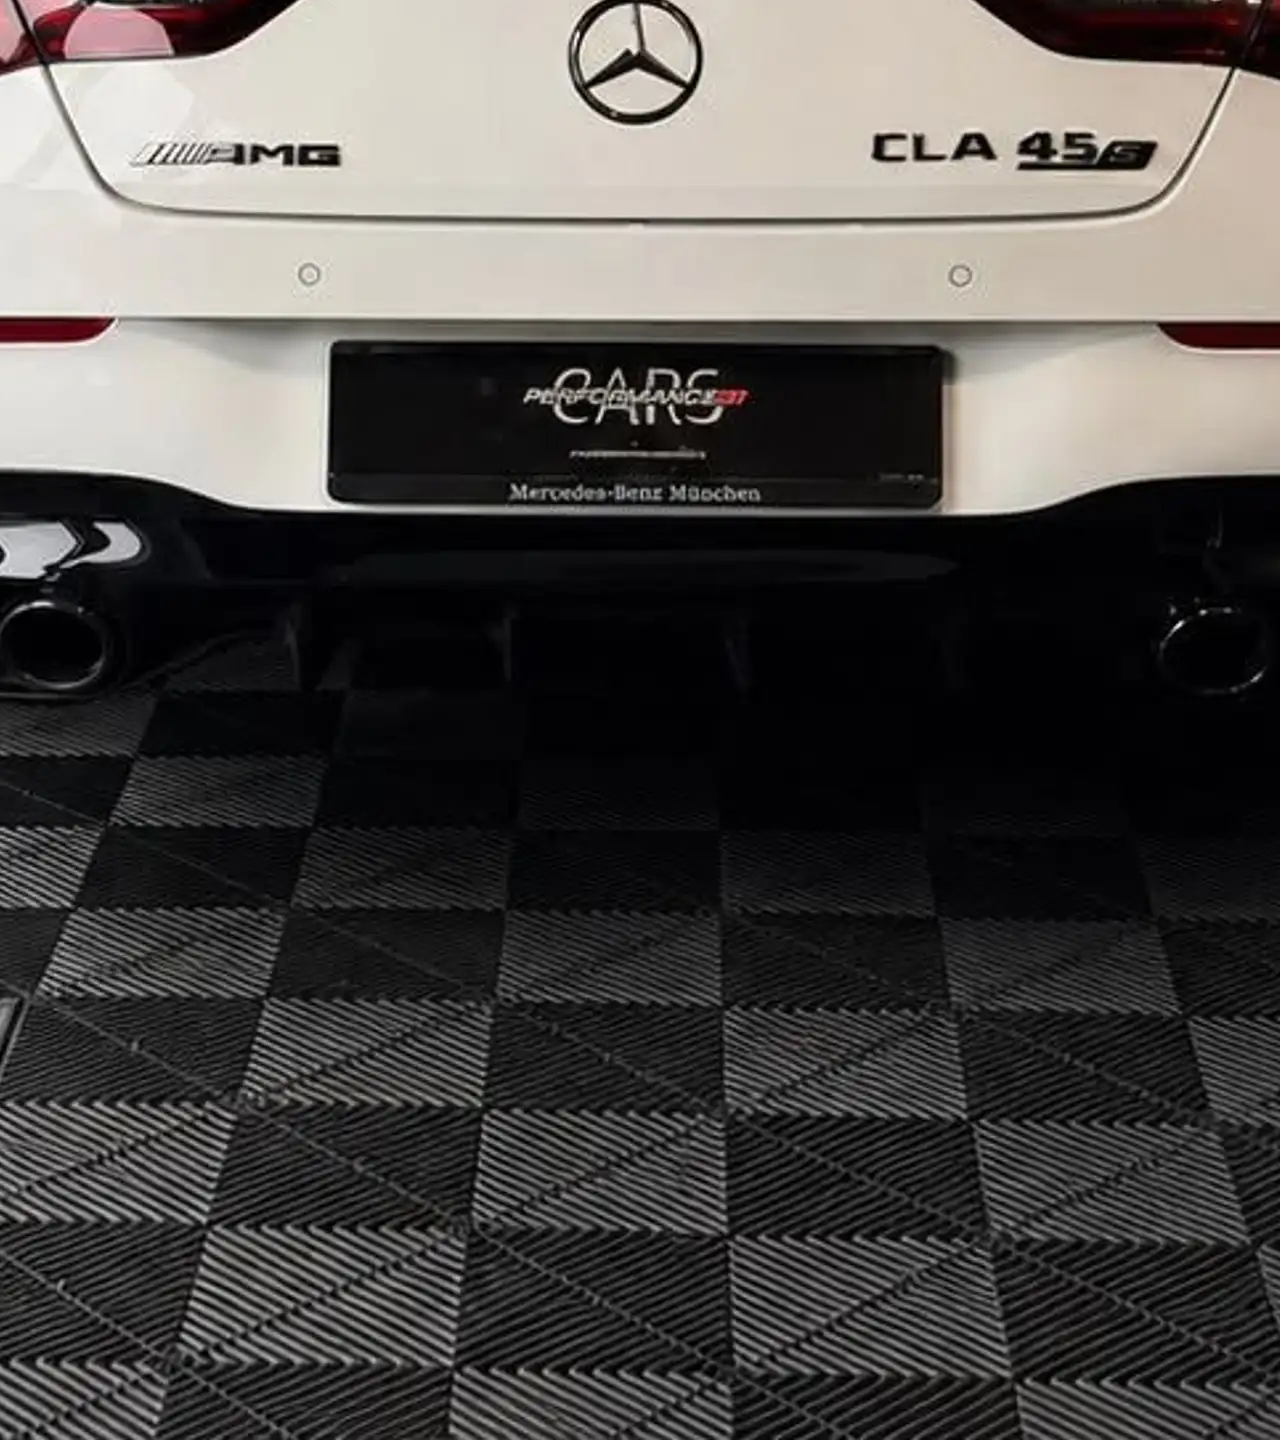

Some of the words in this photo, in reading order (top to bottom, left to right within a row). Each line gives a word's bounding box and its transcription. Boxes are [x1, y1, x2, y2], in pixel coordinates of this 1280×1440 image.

[203, 142, 341, 166] AMG
[871, 132, 997, 162] CLA
[553, 367, 723, 426] CARS
[509, 482, 664, 502] Mercedes-Benz
[670, 483, 761, 502] München
